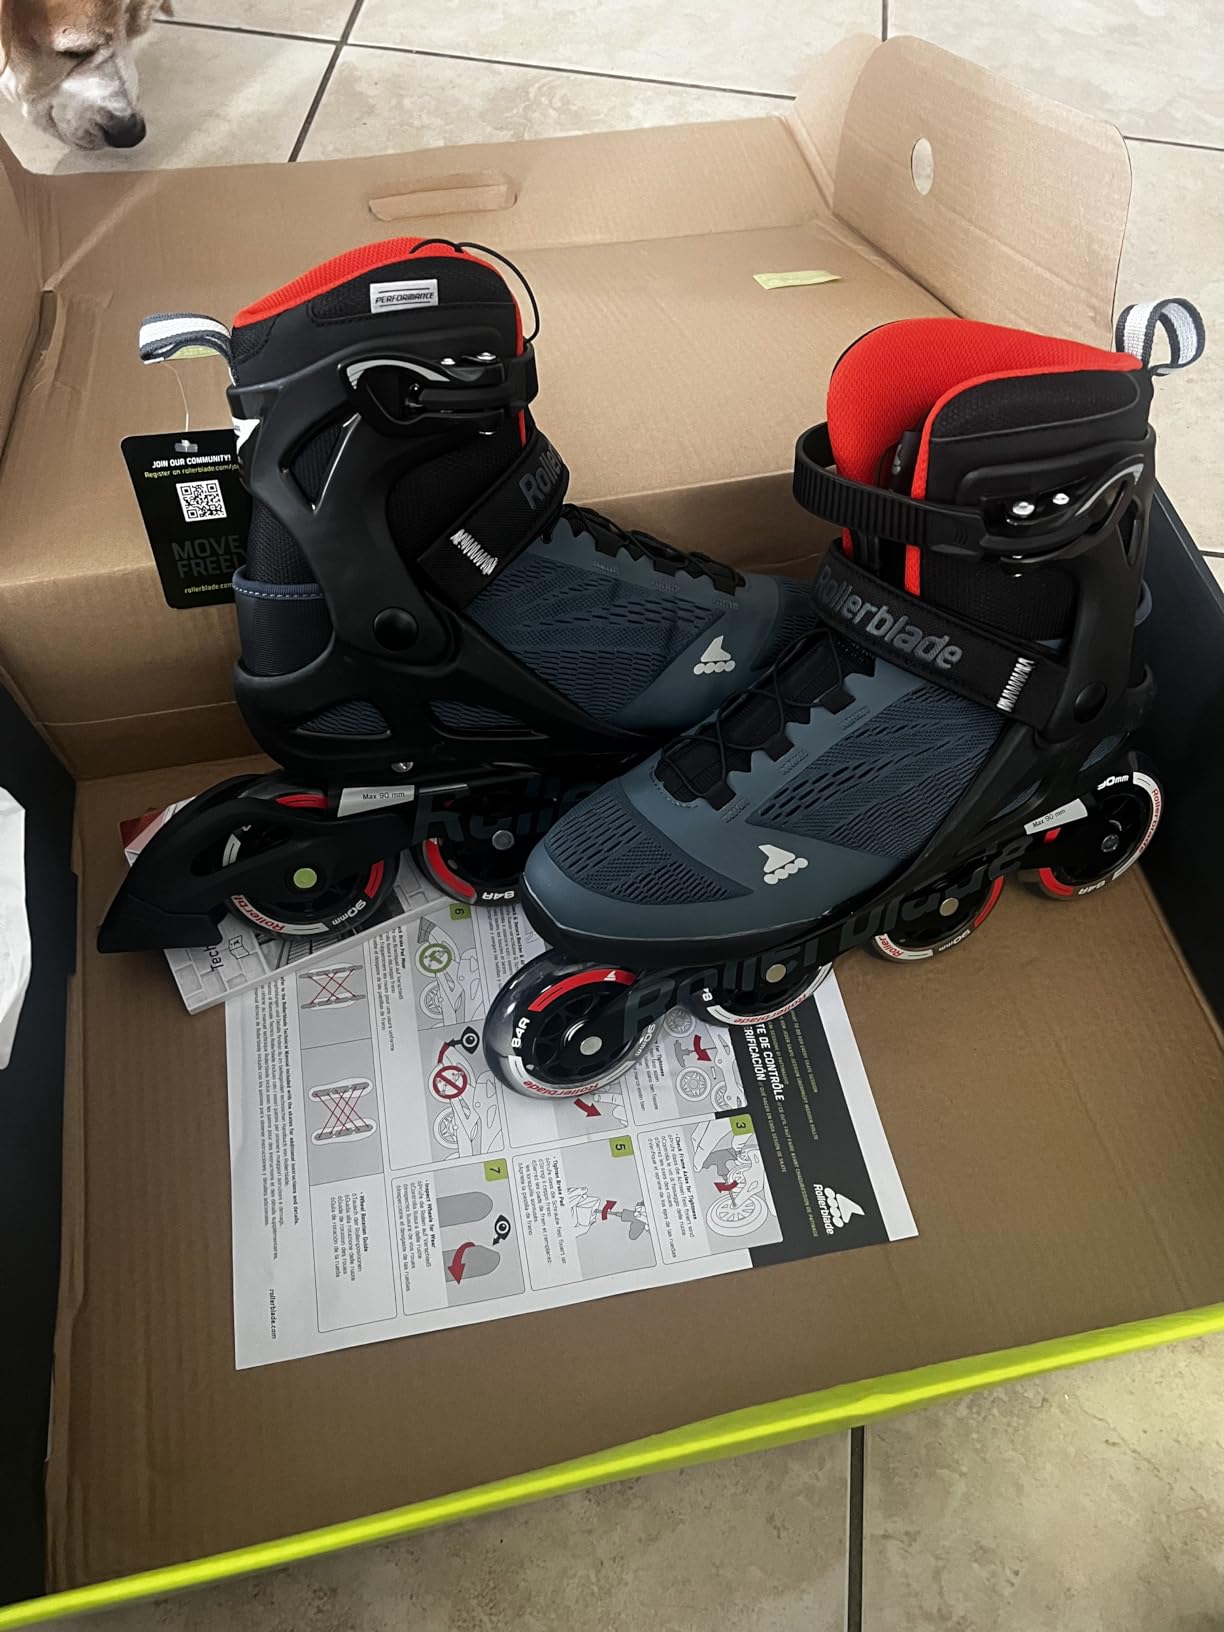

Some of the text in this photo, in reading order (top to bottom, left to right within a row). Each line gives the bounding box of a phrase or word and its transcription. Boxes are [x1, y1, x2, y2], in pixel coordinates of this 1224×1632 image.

[375, 292, 434, 304] PERFORMANCE
[152, 454, 231, 468] JOIN OUR COMMUNITY!
[144, 470, 170, 479] Register
[172, 535, 241, 560] MOVE
[184, 582, 233, 594] rollerblade.com
[816, 565, 963, 669] Rollerblade
[379, 792, 390, 800] 90
[392, 791, 405, 799] mm
[1032, 809, 1066, 828] Max 90 mm
[332, 899, 367, 926] 90mm
[880, 936, 905, 958] Roller
[939, 929, 971, 951] 90mm
[635, 1023, 656, 1056] 90mm
[742, 1026, 768, 1080] RIFICACIÓN
[754, 1023, 766, 1034] TE
[761, 1050, 787, 1101] CONTRÔLE
[523, 1079, 599, 1097] Rollerblade
[555, 1179, 563, 1195] Brake
[677, 1153, 686, 1169] Frame
[687, 1194, 698, 1220] Tightness
[812, 1183, 836, 1235] Rollerblade
[268, 1288, 277, 1340] rollerblade.com
